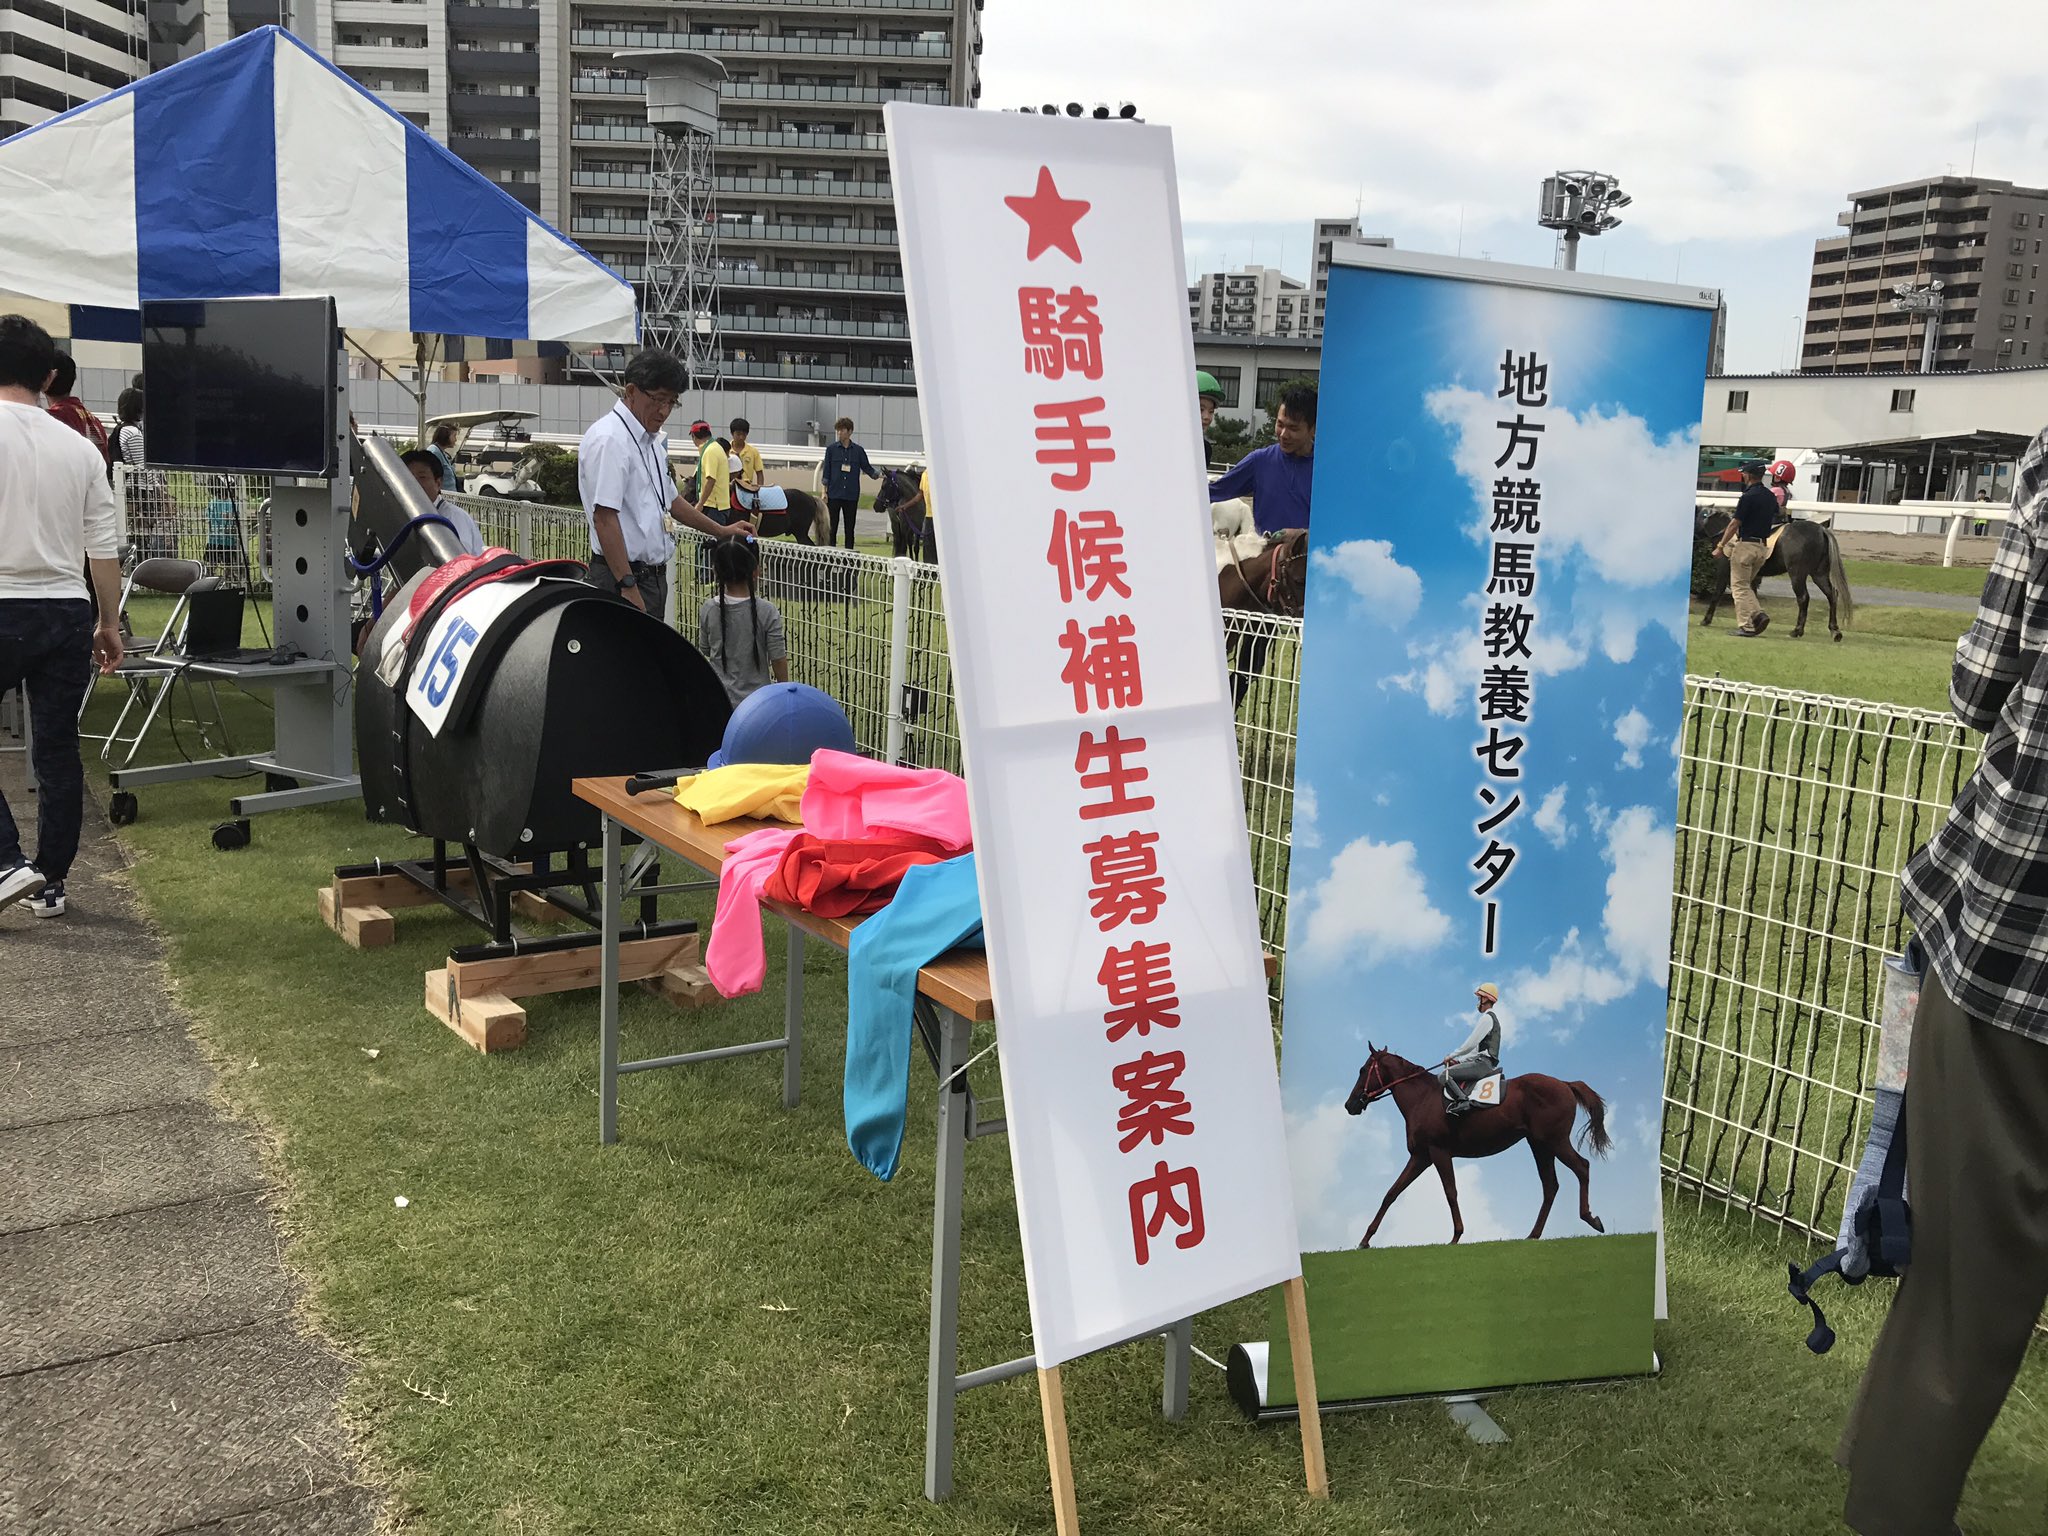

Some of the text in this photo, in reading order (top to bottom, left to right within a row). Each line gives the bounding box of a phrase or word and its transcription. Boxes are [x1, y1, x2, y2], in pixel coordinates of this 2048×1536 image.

[1776, 464, 1785, 476] 3
[418, 615, 480, 708] 15
[1472, 348, 1549, 954] 地方競馬教養センター
[1018, 285, 1206, 1265] 騎手候補生募集案内
[1479, 1081, 1494, 1100] 8
